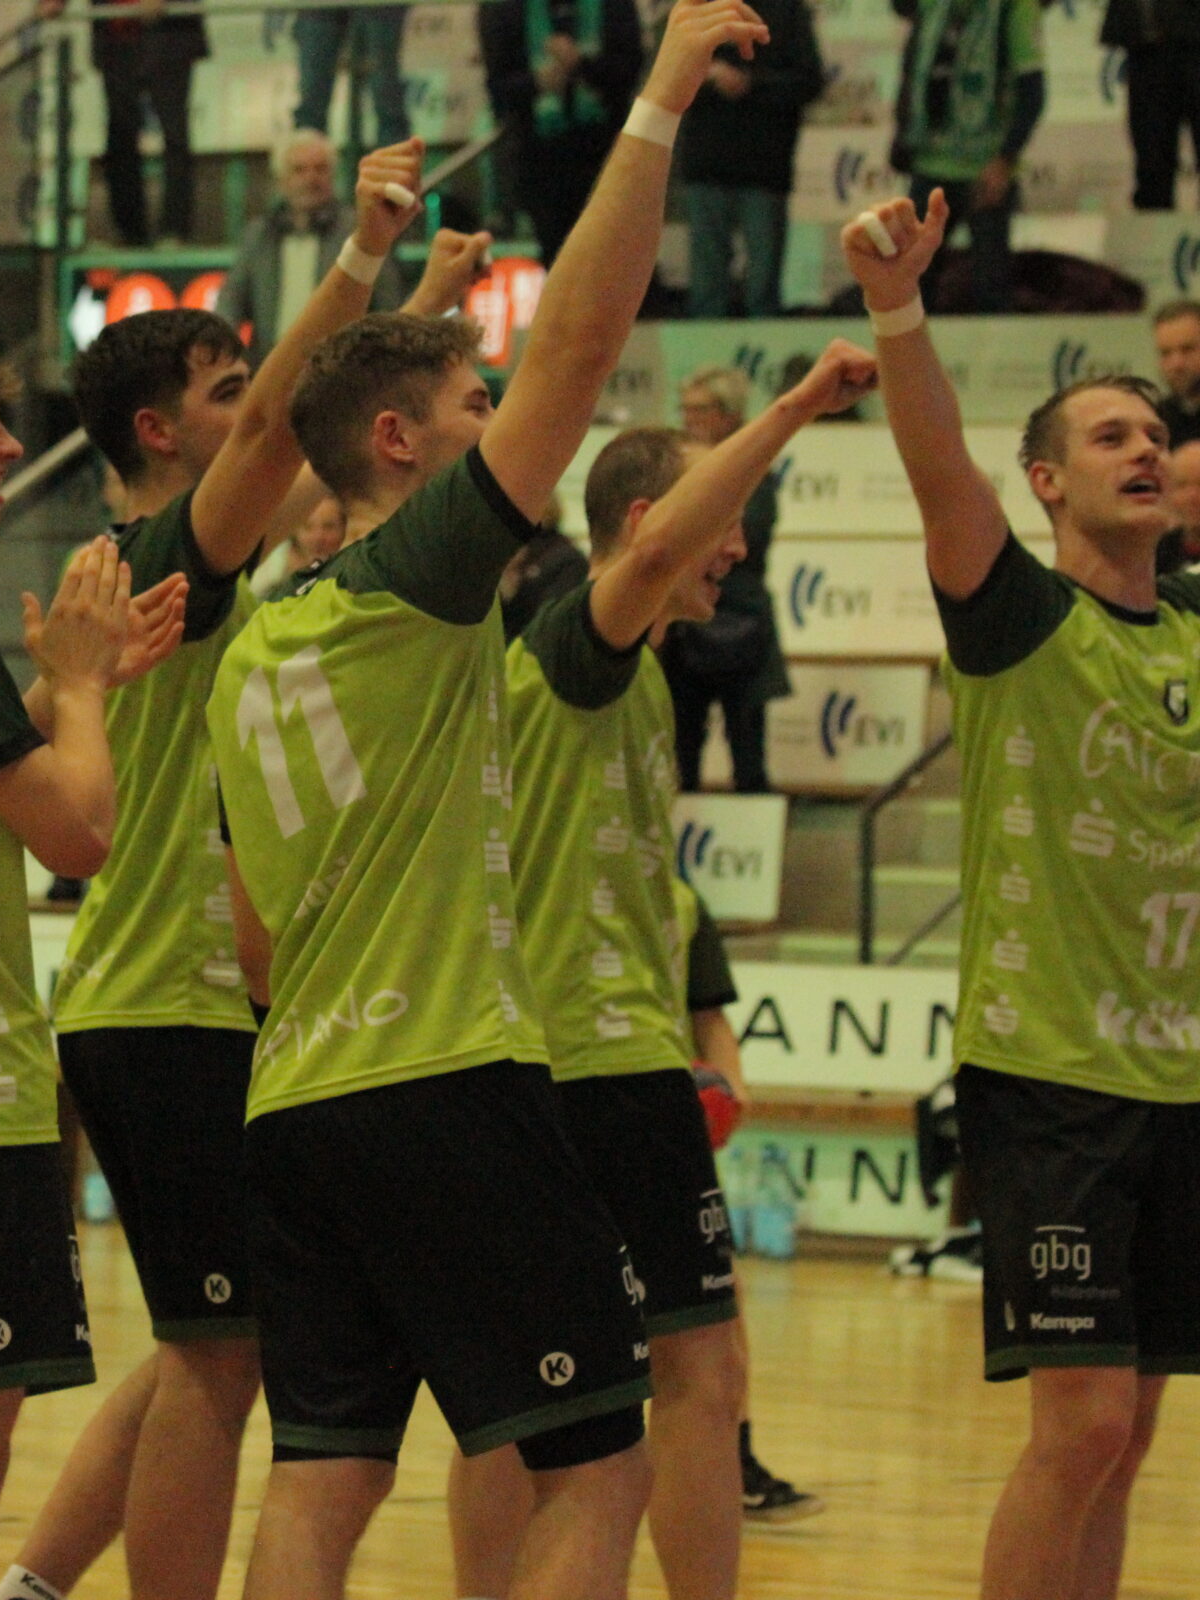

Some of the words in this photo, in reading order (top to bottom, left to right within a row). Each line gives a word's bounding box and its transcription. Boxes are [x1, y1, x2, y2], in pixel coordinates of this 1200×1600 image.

[237, 644, 367, 839] 11
[853, 714, 906, 746] EVI
[711, 846, 763, 880] EVI
[1141, 892, 1200, 969] 17
[1030, 1233, 1091, 1280] gbg
[1030, 1312, 1095, 1334] Kempa
